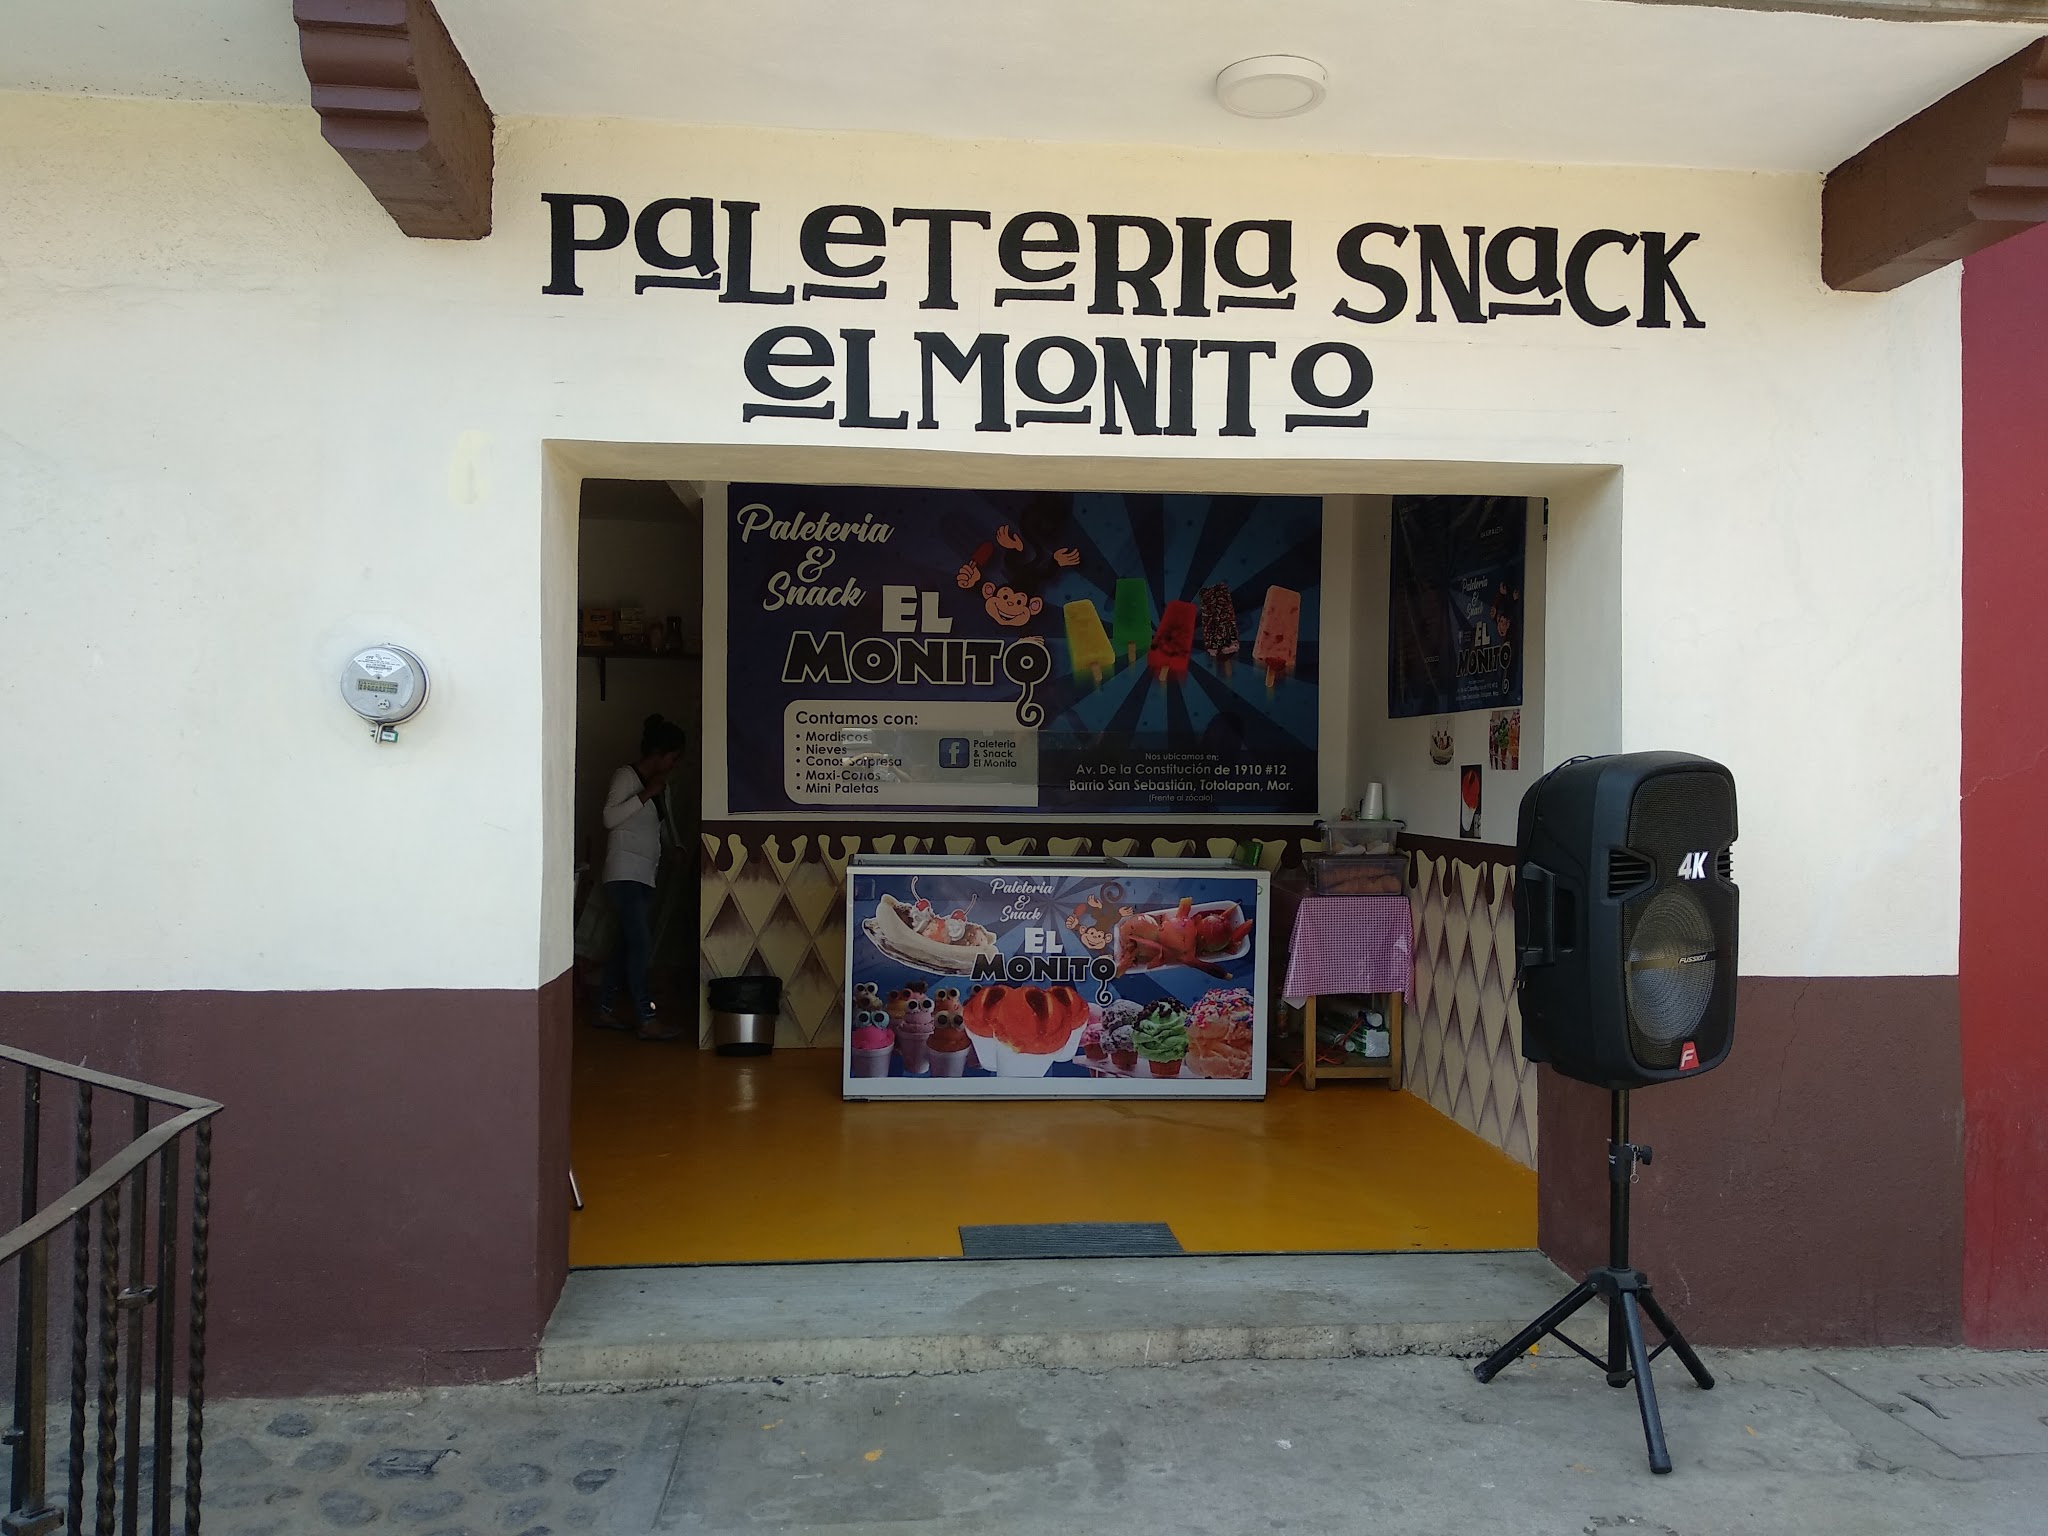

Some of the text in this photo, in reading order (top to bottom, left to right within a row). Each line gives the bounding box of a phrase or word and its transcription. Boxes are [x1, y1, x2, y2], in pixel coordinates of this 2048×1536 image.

[737, 503, 895, 543] Paleteria
[797, 546, 836, 583] &
[763, 570, 867, 612] Snack
[882, 584, 954, 634] EL
[1474, 621, 1492, 647] EL
[781, 631, 1051, 686] MONITO
[1455, 644, 1512, 678] MONITO
[796, 711, 919, 726] Contamos con:
[805, 731, 869, 743] Mordiscos
[973, 739, 1016, 749] Paleteria
[805, 744, 848, 756] Nieves
[973, 749, 1014, 759] & Snack
[1145, 752, 1220, 762] Nos ubicamos en:
[983, 759, 1018, 768] Monito
[1076, 762, 1288, 777] Av. De la Constitución de 1910 #12
[805, 770, 882, 782] Maxi-Conos
[805, 783, 880, 795] Mini Paletas
[1069, 779, 1295, 793] Barrio San Sebastián, Totolapan, Mor.
[1149, 793, 1175, 802] (Frente
[1678, 851, 1710, 880] 4K
[989, 878, 1055, 897] Paleteria
[1013, 895, 1031, 909] &
[999, 905, 1044, 922] Snack
[1024, 927, 1064, 954] EL
[969, 953, 1117, 983] MONITO
